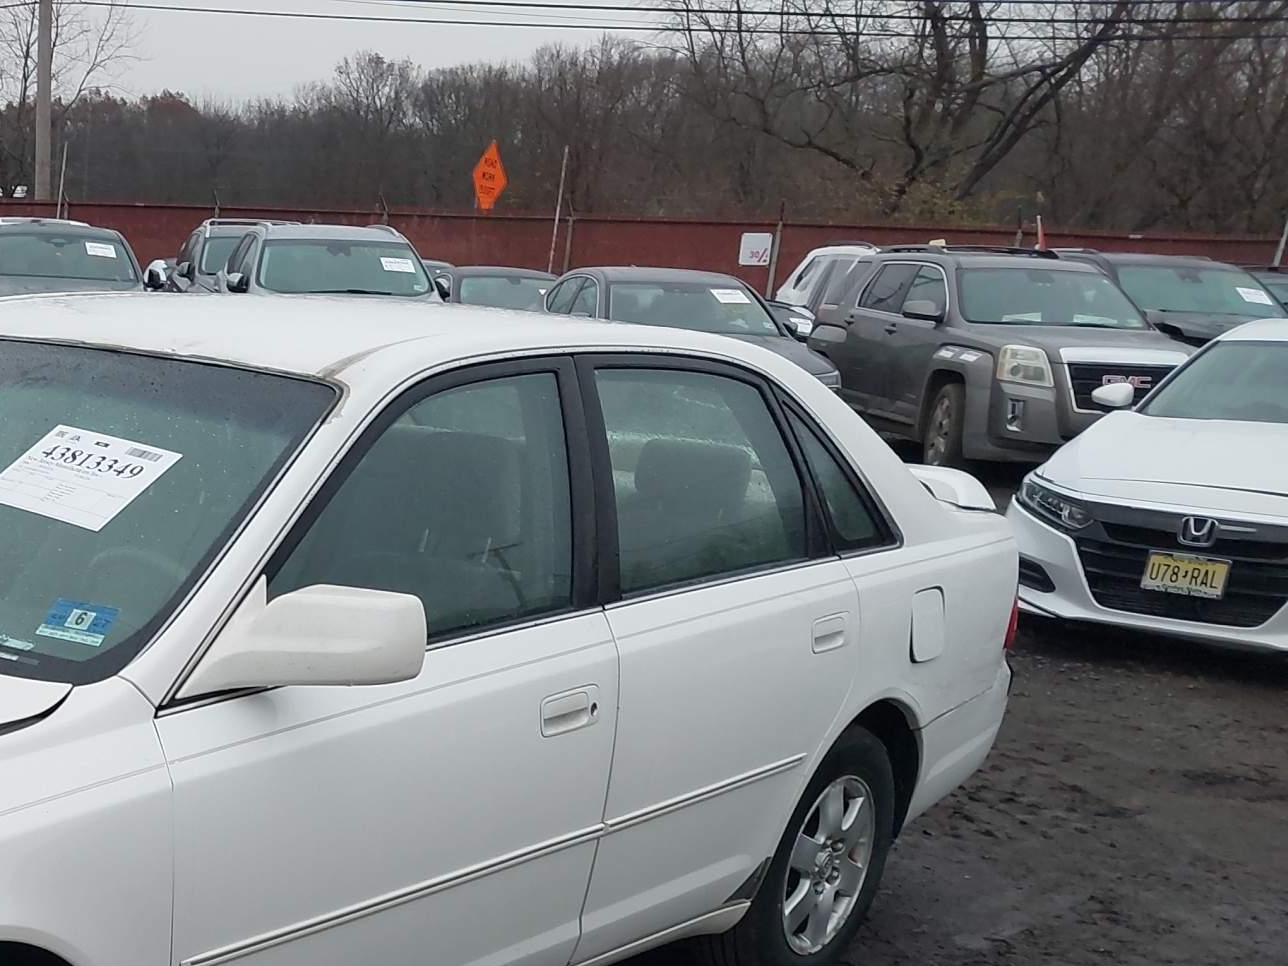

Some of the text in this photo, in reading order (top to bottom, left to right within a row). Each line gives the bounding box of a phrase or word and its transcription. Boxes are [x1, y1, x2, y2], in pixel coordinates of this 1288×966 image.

[1102, 374, 1153, 389] GMC
[41, 444, 145, 480] 43813349
[1189, 567, 1218, 589] RAL
[74, 611, 88, 626] 6
